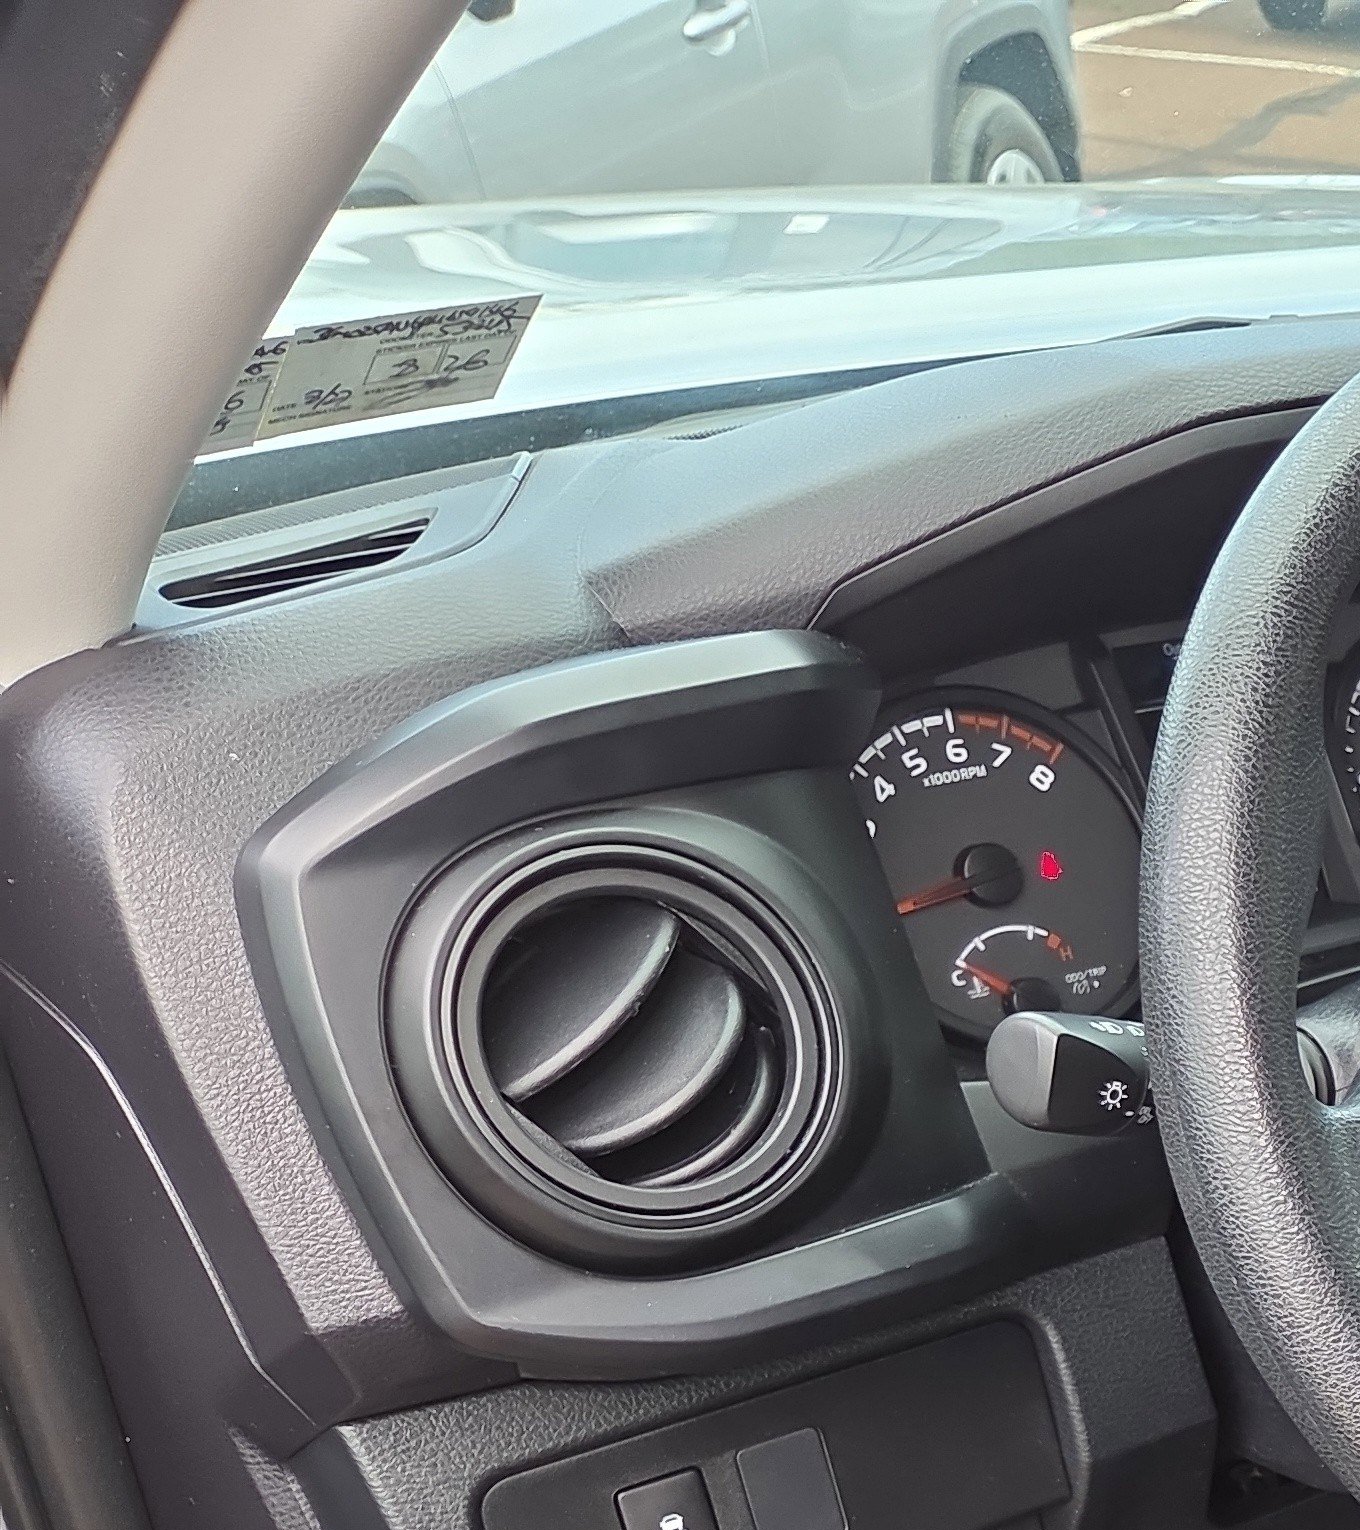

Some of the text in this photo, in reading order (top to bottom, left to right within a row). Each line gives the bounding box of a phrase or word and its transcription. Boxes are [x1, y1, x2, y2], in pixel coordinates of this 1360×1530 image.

[901, 748, 928, 777] 5
[944, 738, 969, 763] 6
[991, 742, 1013, 768] 7
[873, 775, 896, 803] 4
[1029, 764, 1056, 792] 8
[951, 969, 967, 987] C
